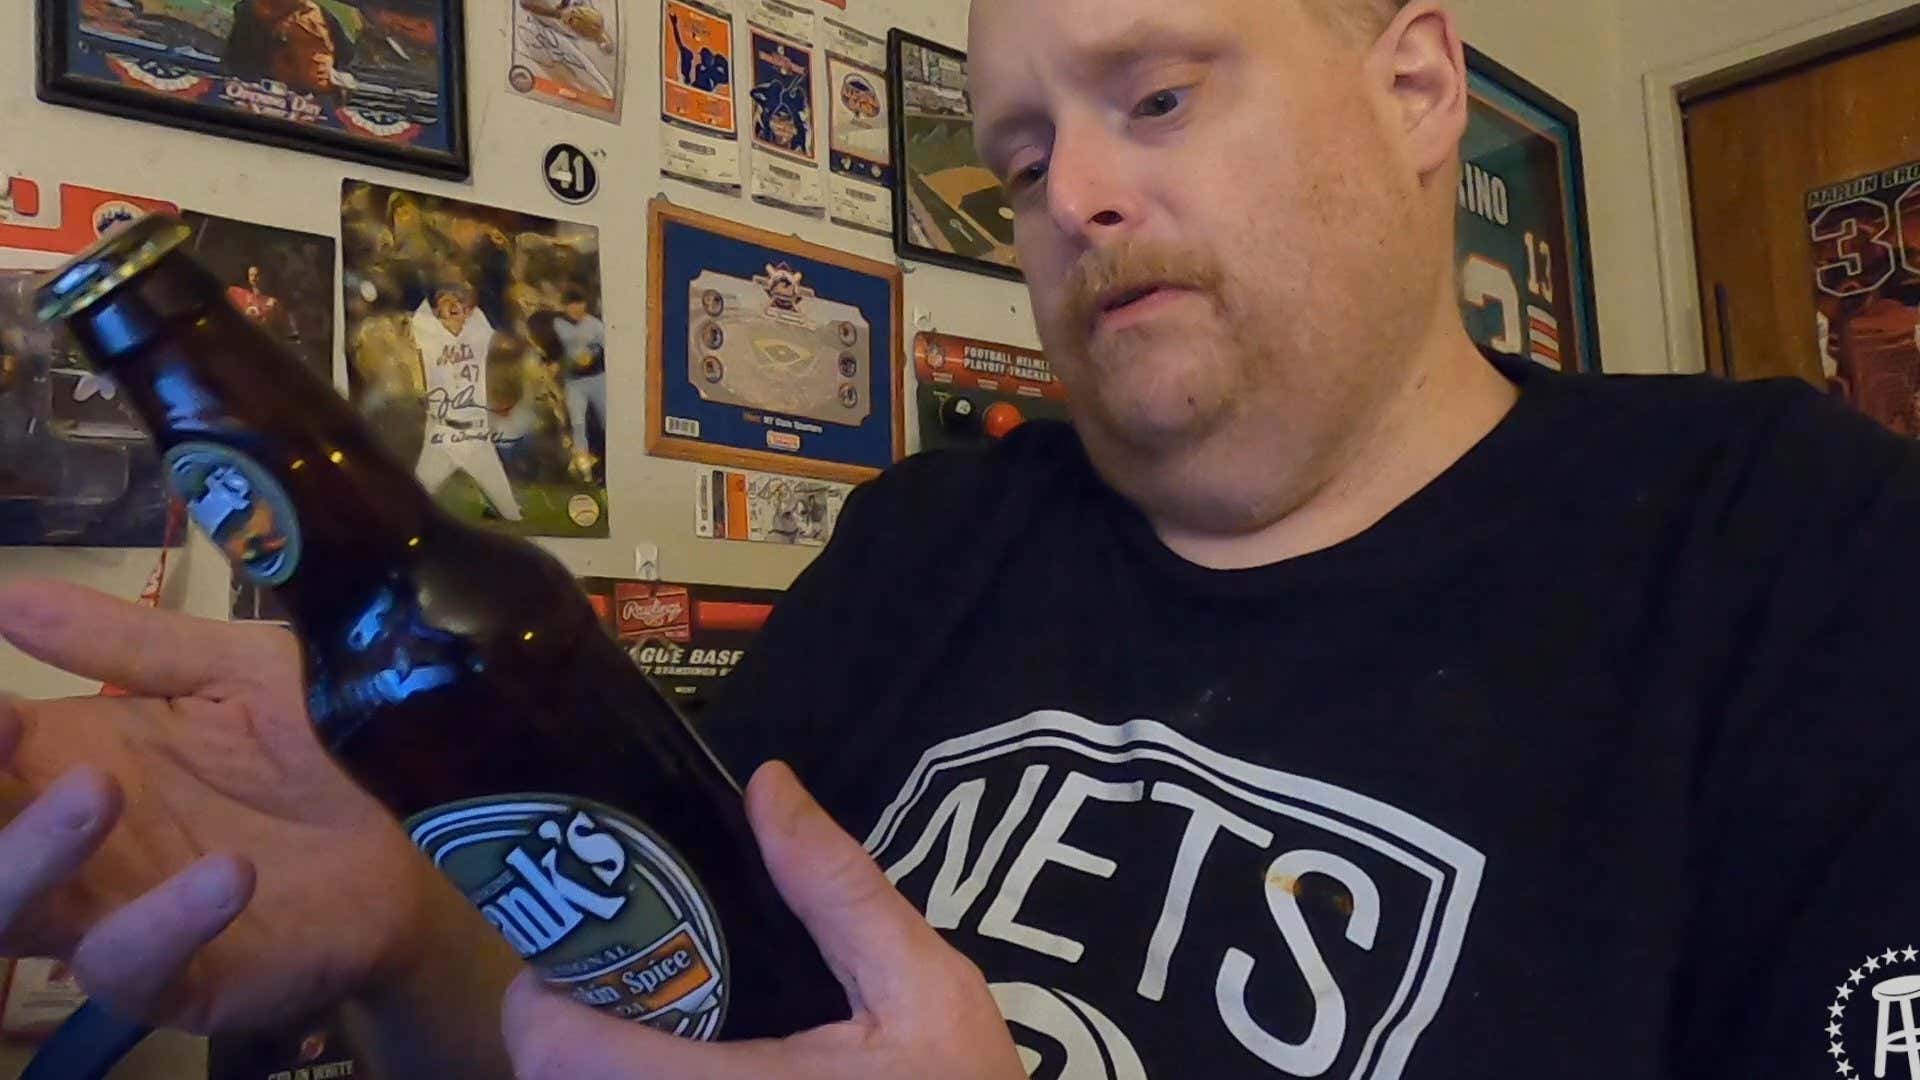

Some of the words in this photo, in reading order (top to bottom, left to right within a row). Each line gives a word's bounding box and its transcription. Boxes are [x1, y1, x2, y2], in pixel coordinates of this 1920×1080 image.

[549, 150, 584, 192] 41
[963, 358, 1005, 376] PLAYOFF
[964, 345, 1012, 365] FOOTBALL
[622, 597, 683, 628] Rawlings
[887, 763, 1381, 1078] NETS
[622, 949, 692, 995] Spice
